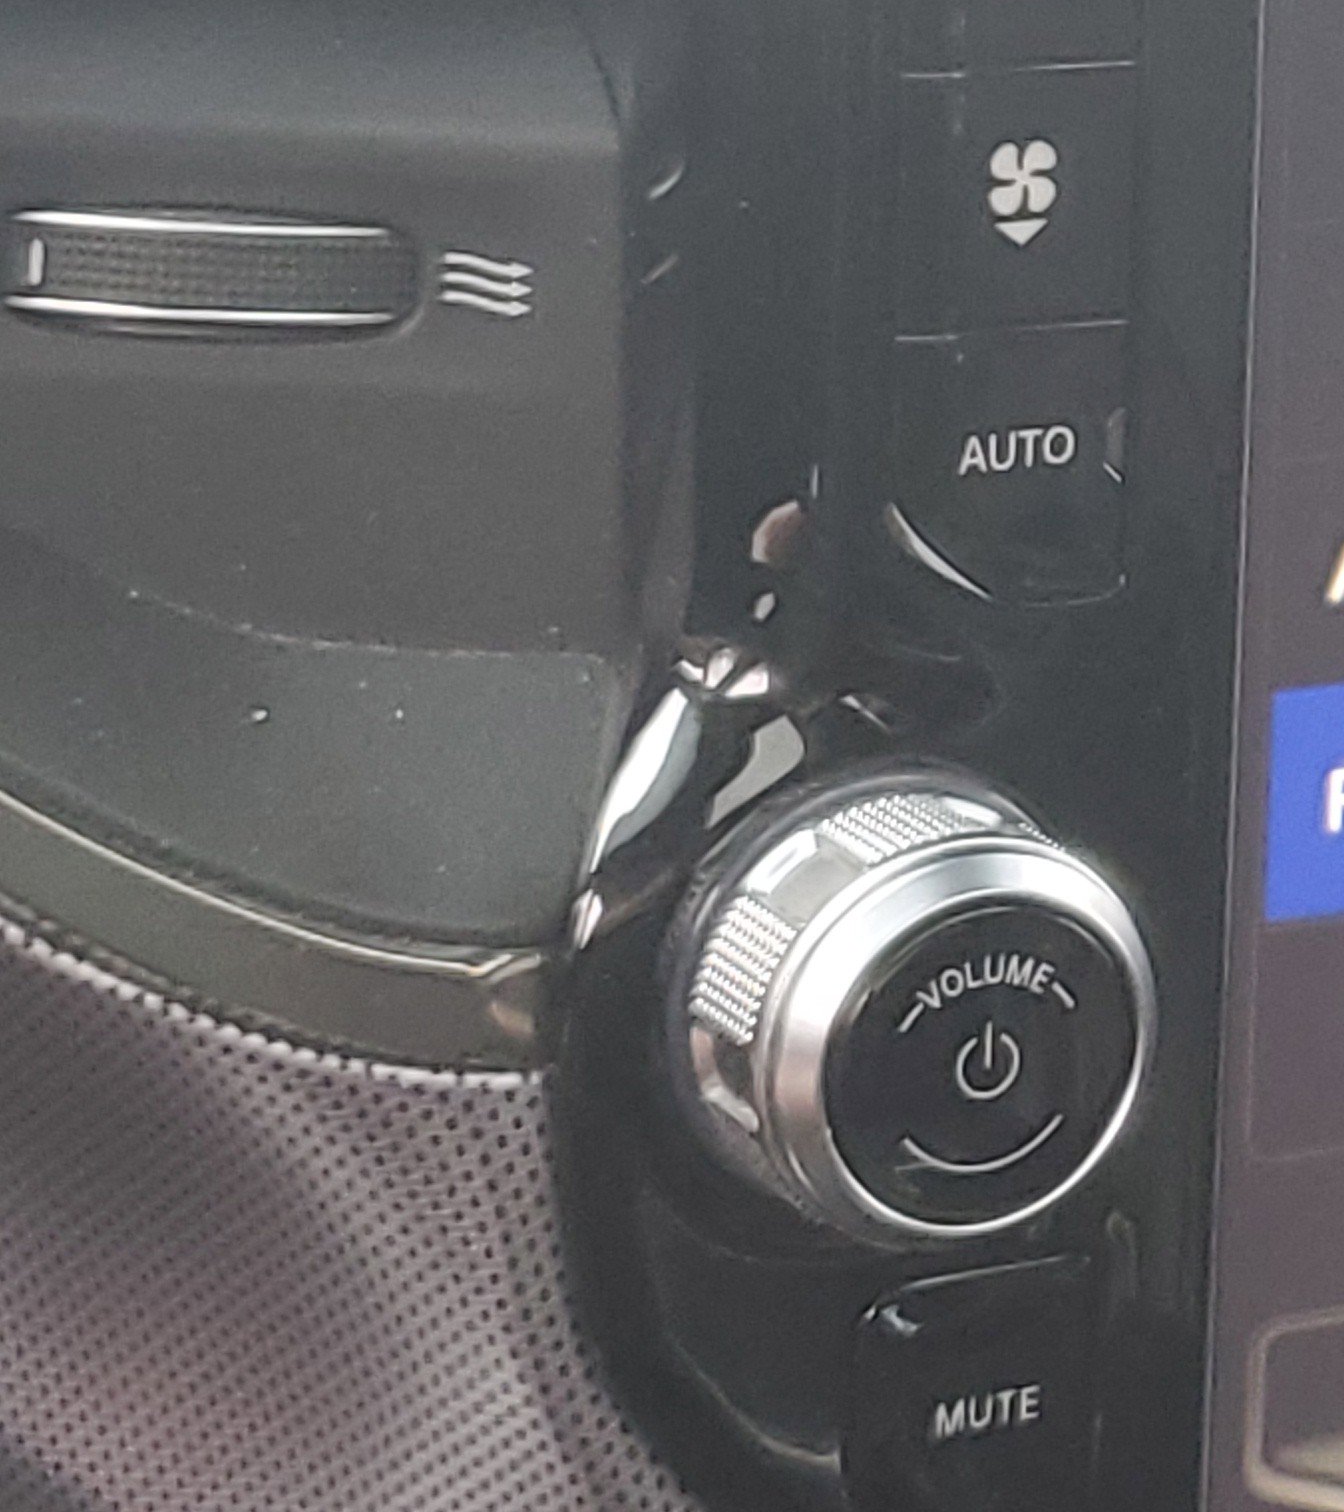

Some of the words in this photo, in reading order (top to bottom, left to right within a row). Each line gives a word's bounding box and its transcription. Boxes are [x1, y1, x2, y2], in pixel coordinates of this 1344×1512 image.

[957, 425, 1077, 476] AUTO
[917, 954, 1055, 1011] VOLUME
[934, 1385, 1040, 1439] MUTE
